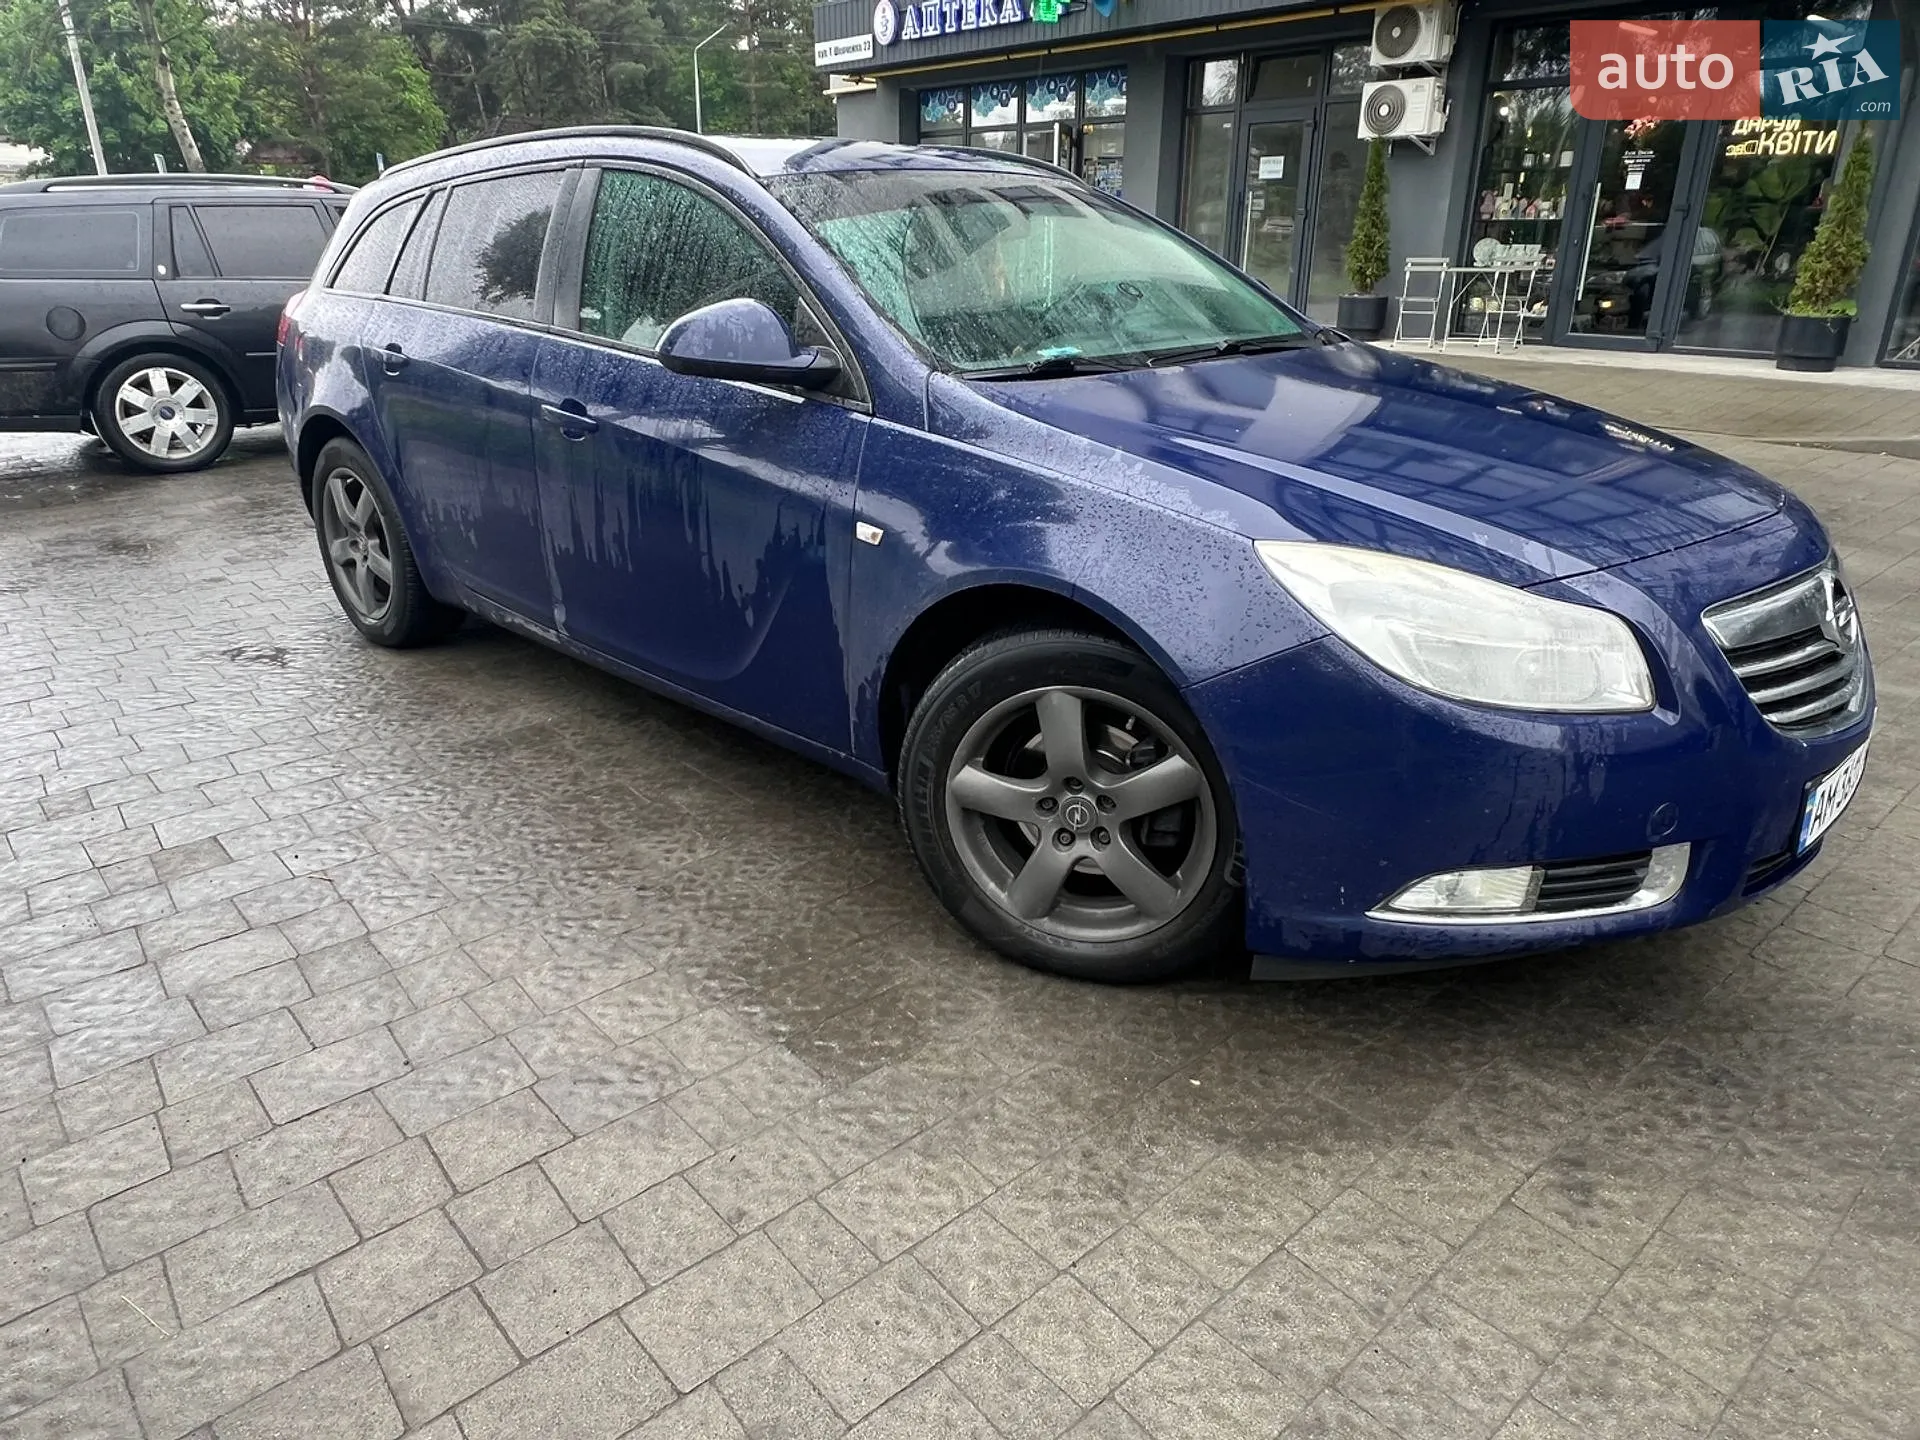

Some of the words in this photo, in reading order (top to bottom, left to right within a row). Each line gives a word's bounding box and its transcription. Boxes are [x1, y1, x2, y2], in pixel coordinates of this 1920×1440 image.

[902, 0, 1024, 40] АПТЕКА
[1731, 113, 1802, 136] ДАРУЙ
[1757, 130, 1838, 155] КВІТИ
